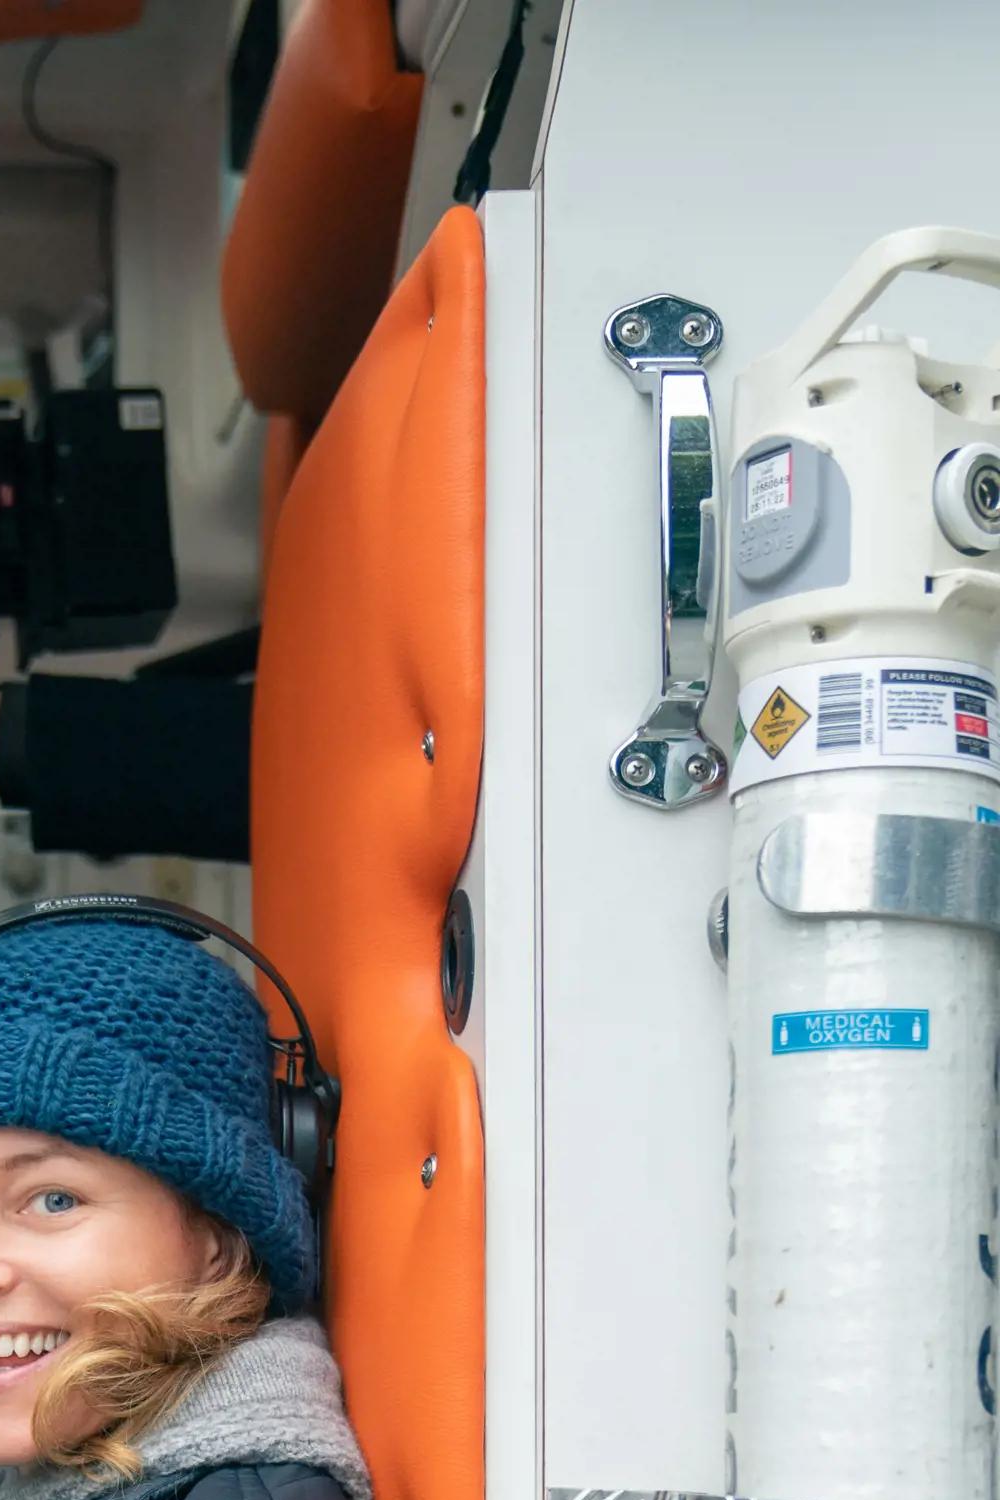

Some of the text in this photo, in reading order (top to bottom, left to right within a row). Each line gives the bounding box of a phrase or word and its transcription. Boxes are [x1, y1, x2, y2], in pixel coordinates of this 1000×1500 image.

[889, 672, 927, 681] PLEASE
[805, 1014, 896, 1030] MEDICAL
[808, 1028, 891, 1044] OXYGEN
